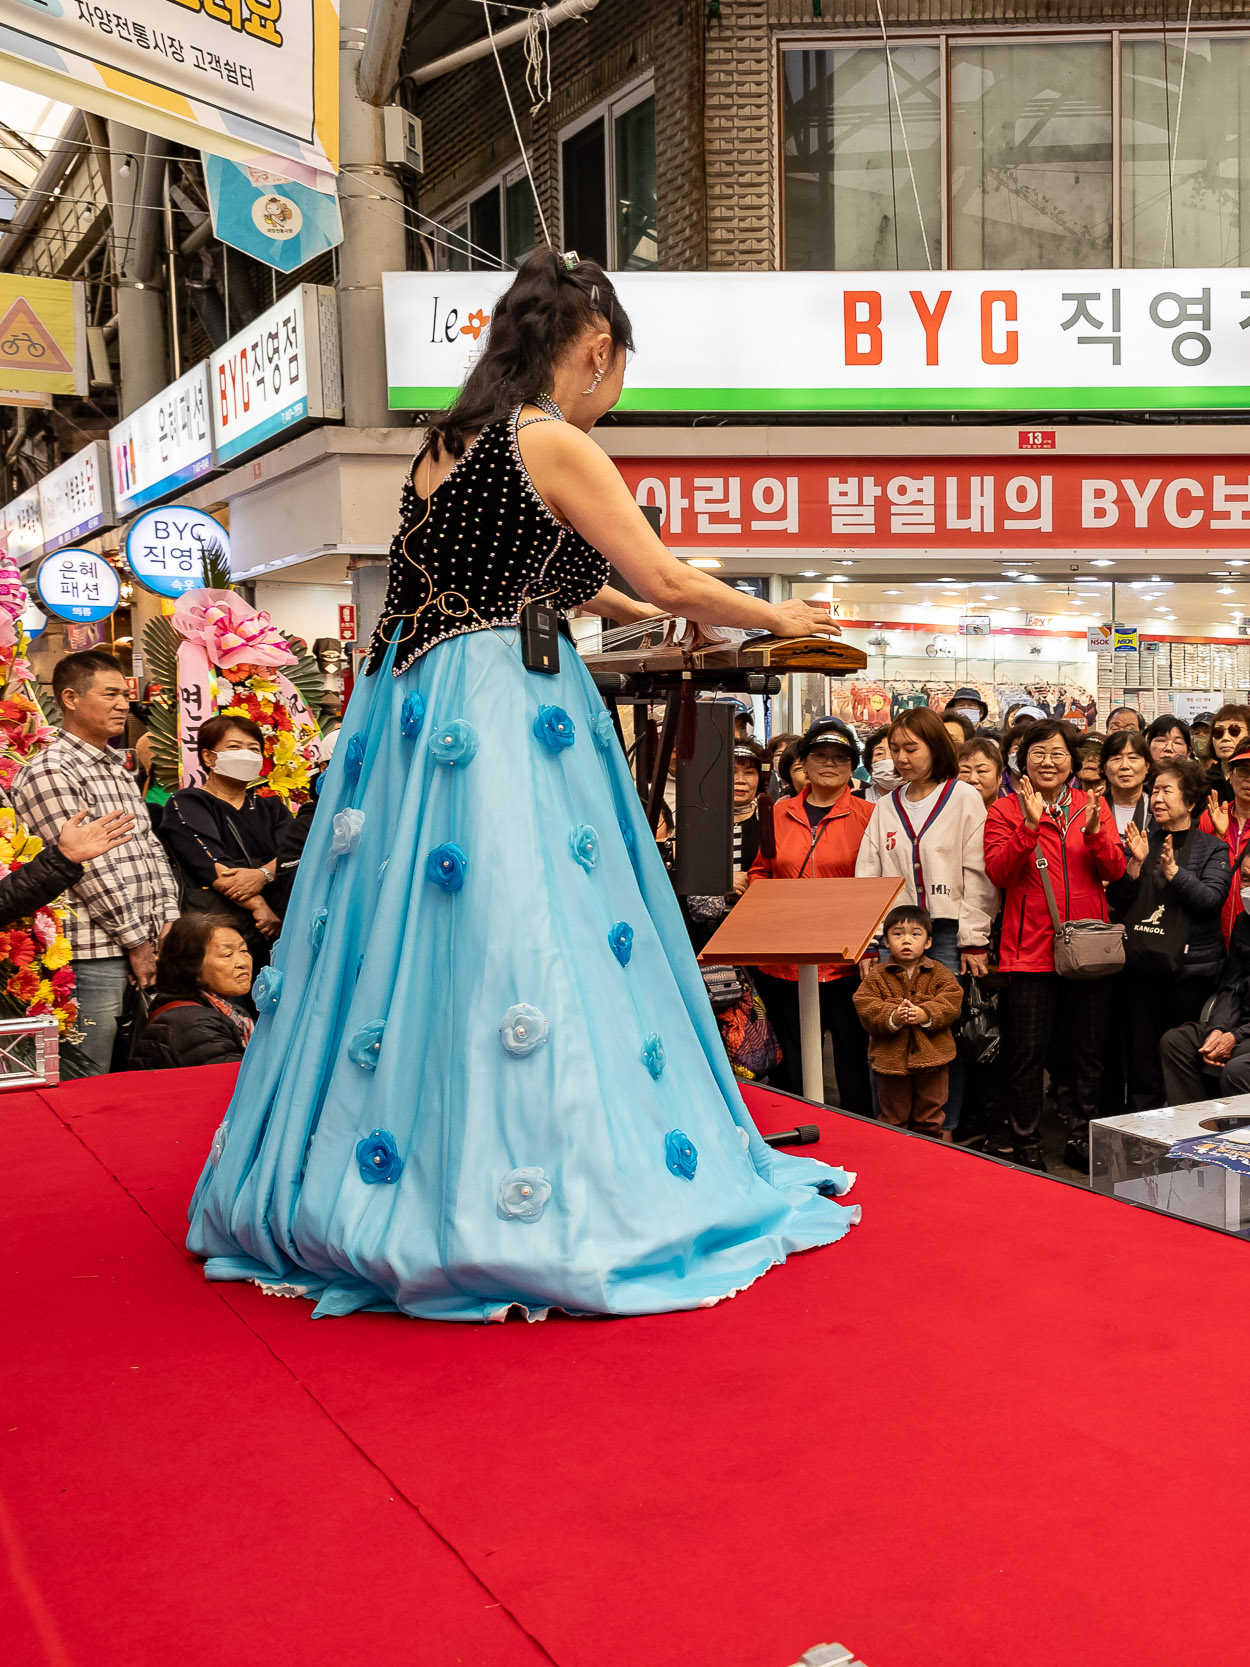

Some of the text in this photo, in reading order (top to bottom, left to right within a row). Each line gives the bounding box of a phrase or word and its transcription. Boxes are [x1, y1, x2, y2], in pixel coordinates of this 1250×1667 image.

[77, 0, 184, 62] 자양전통시장
[190, 45, 255, 91] 고객쉼터
[843, 290, 1018, 366] BYC
[219, 308, 299, 427] BYC 직영점
[1027, 432, 1042, 445] 13
[828, 475, 1054, 534] 발열내의
[154, 520, 207, 541] BYC
[59, 560, 98, 580] 은혜
[60, 582, 100, 601] 패션
[885, 831, 897, 851] 5
[1133, 924, 1165, 935] KANGOL
